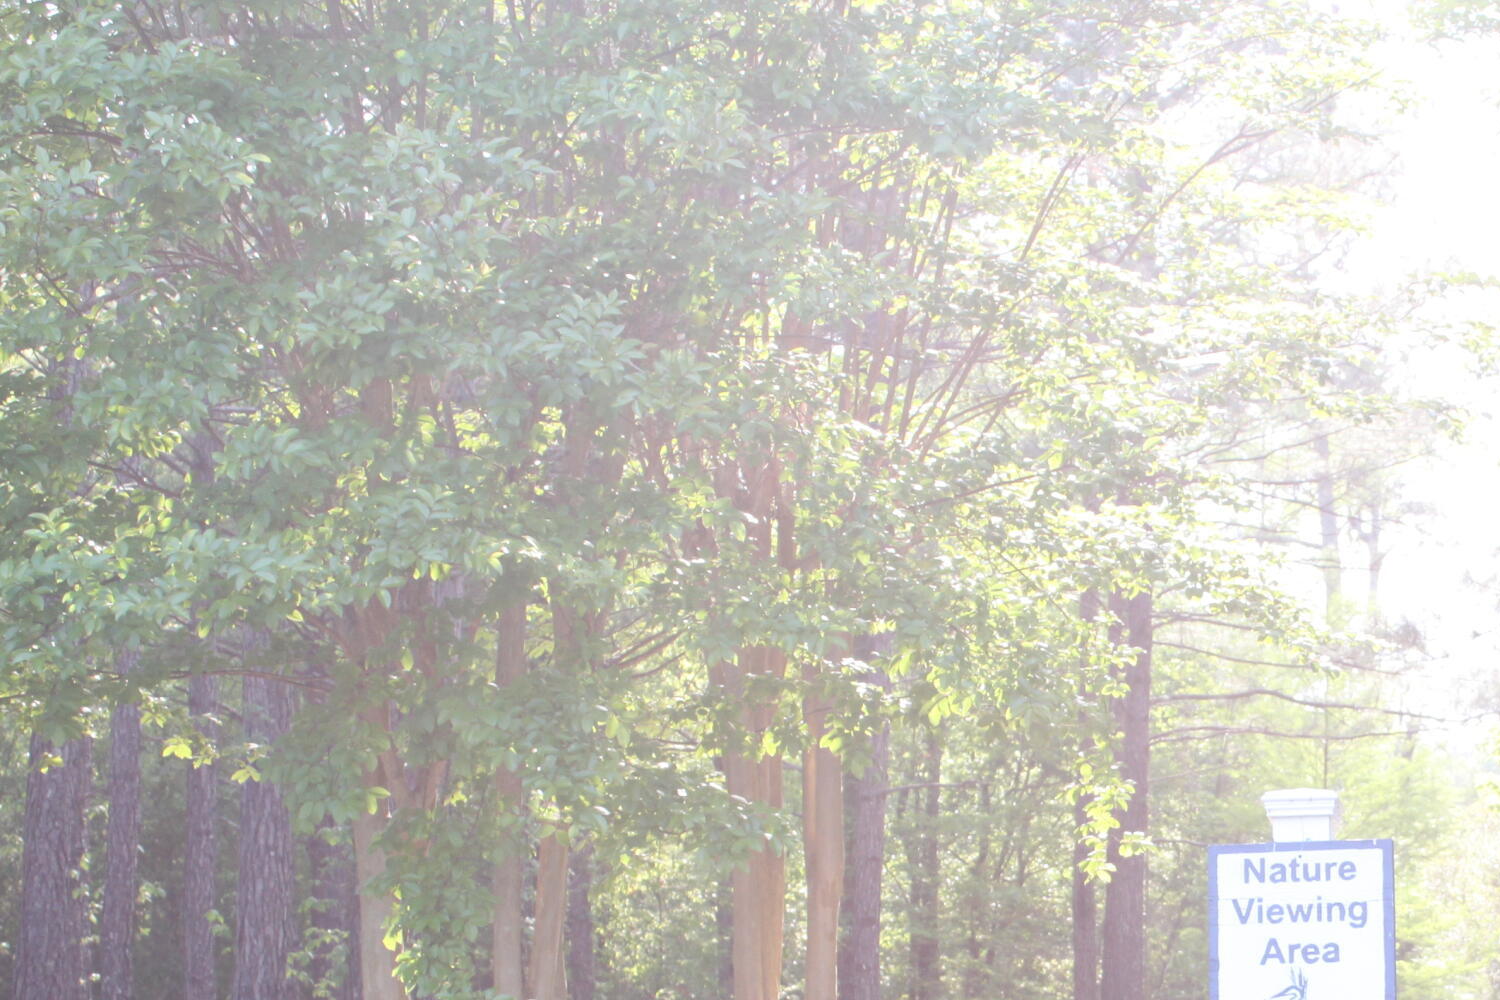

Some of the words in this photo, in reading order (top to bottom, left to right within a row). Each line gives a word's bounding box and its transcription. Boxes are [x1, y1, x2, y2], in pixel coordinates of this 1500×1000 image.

[1243, 857, 1357, 884] Nature
[1231, 896, 1369, 929] Viewing
[1259, 937, 1341, 966] Area
